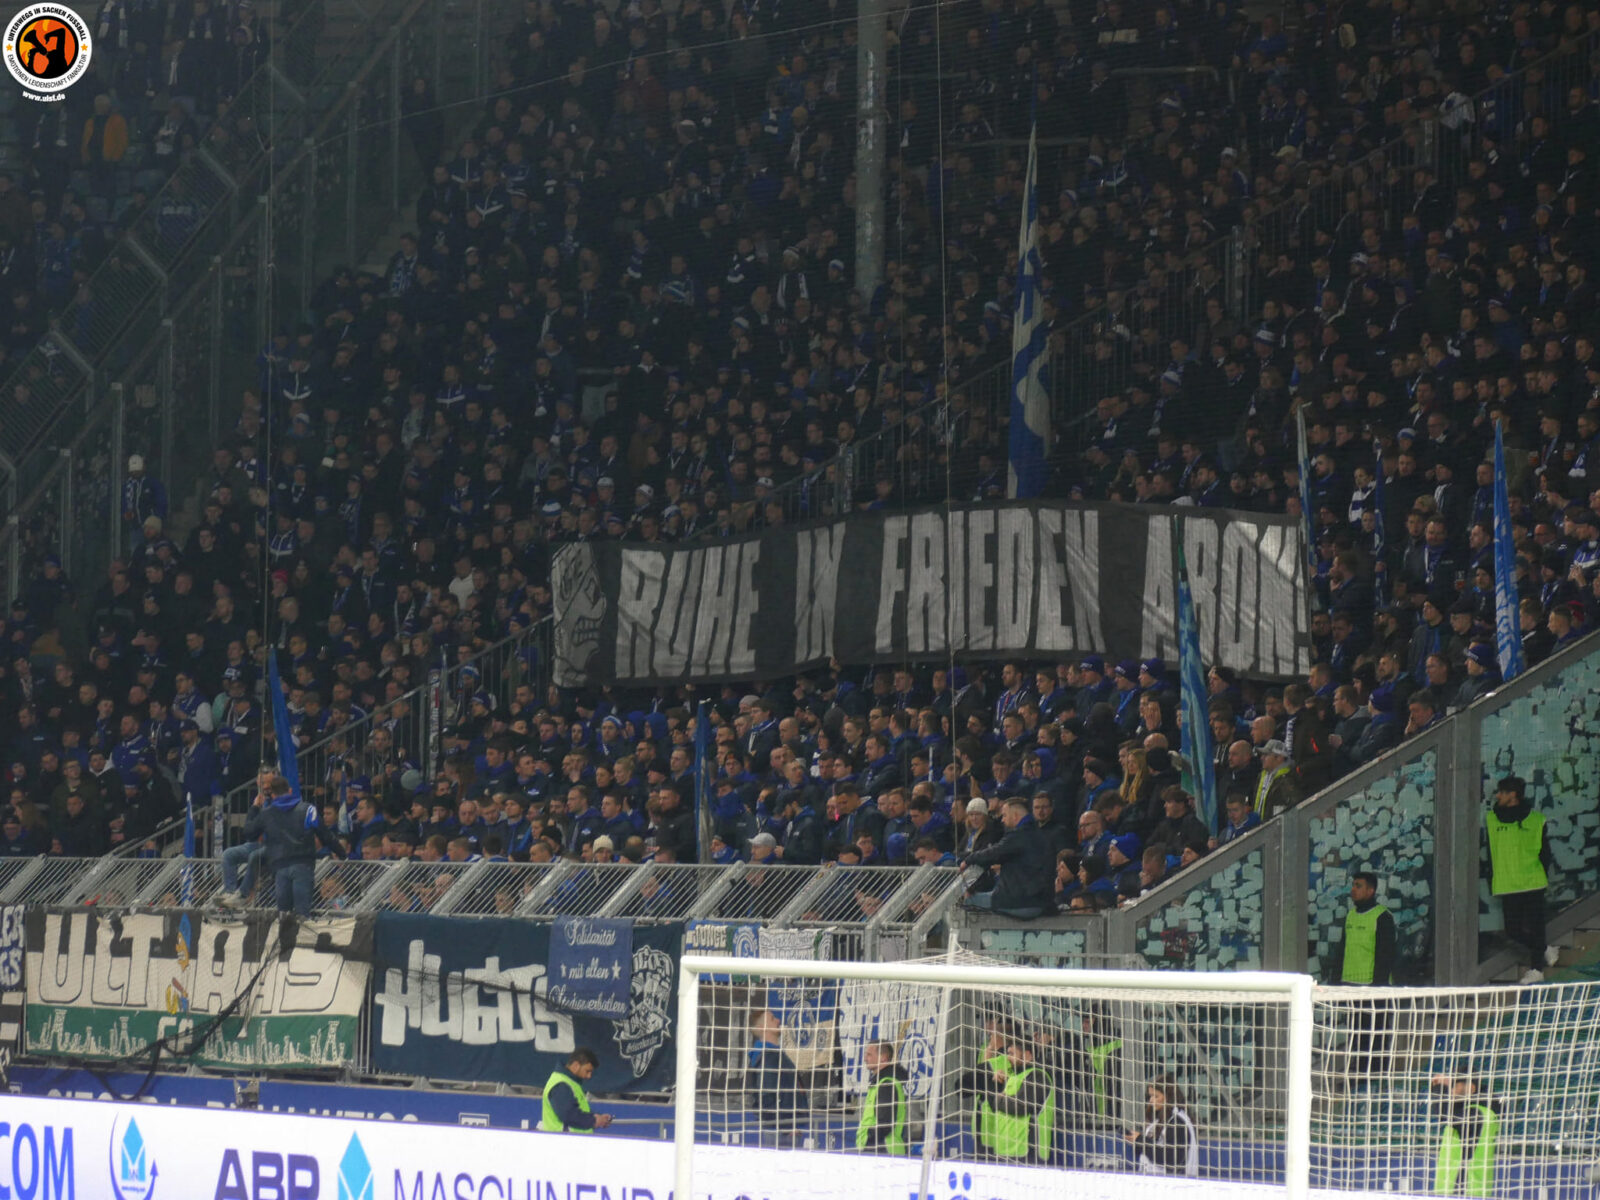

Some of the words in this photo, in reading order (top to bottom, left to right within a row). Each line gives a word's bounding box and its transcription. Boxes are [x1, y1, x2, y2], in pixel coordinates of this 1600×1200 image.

[614, 540, 762, 680] RUHE
[794, 521, 846, 664] IN
[875, 507, 1107, 655] FRIEDEN
[1140, 514, 1312, 676] ARON!
[38, 912, 357, 1015] ULTRAS
[568, 963, 584, 980] mit
